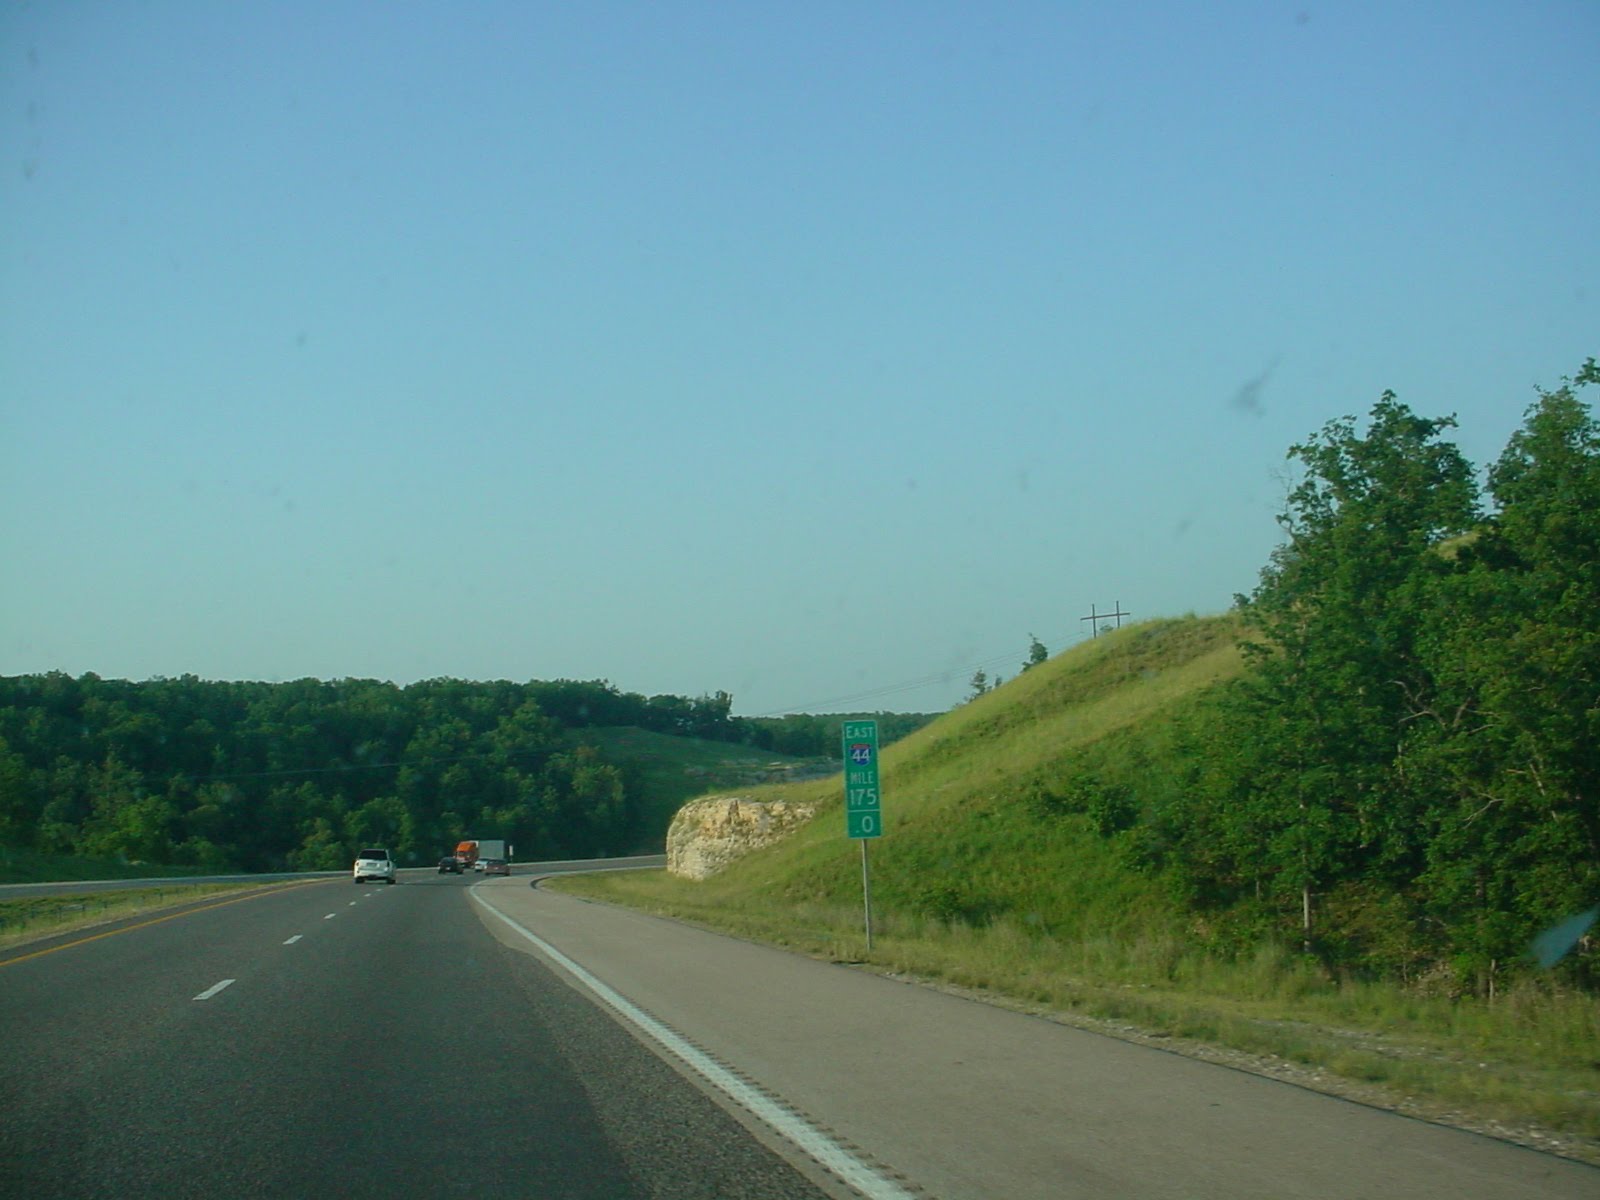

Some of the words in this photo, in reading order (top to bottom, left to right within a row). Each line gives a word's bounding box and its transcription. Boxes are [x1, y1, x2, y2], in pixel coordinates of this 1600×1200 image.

[846, 726, 873, 739] EAST
[852, 749, 870, 762] 44
[850, 771, 874, 784] MILE
[850, 788, 876, 805] 175
